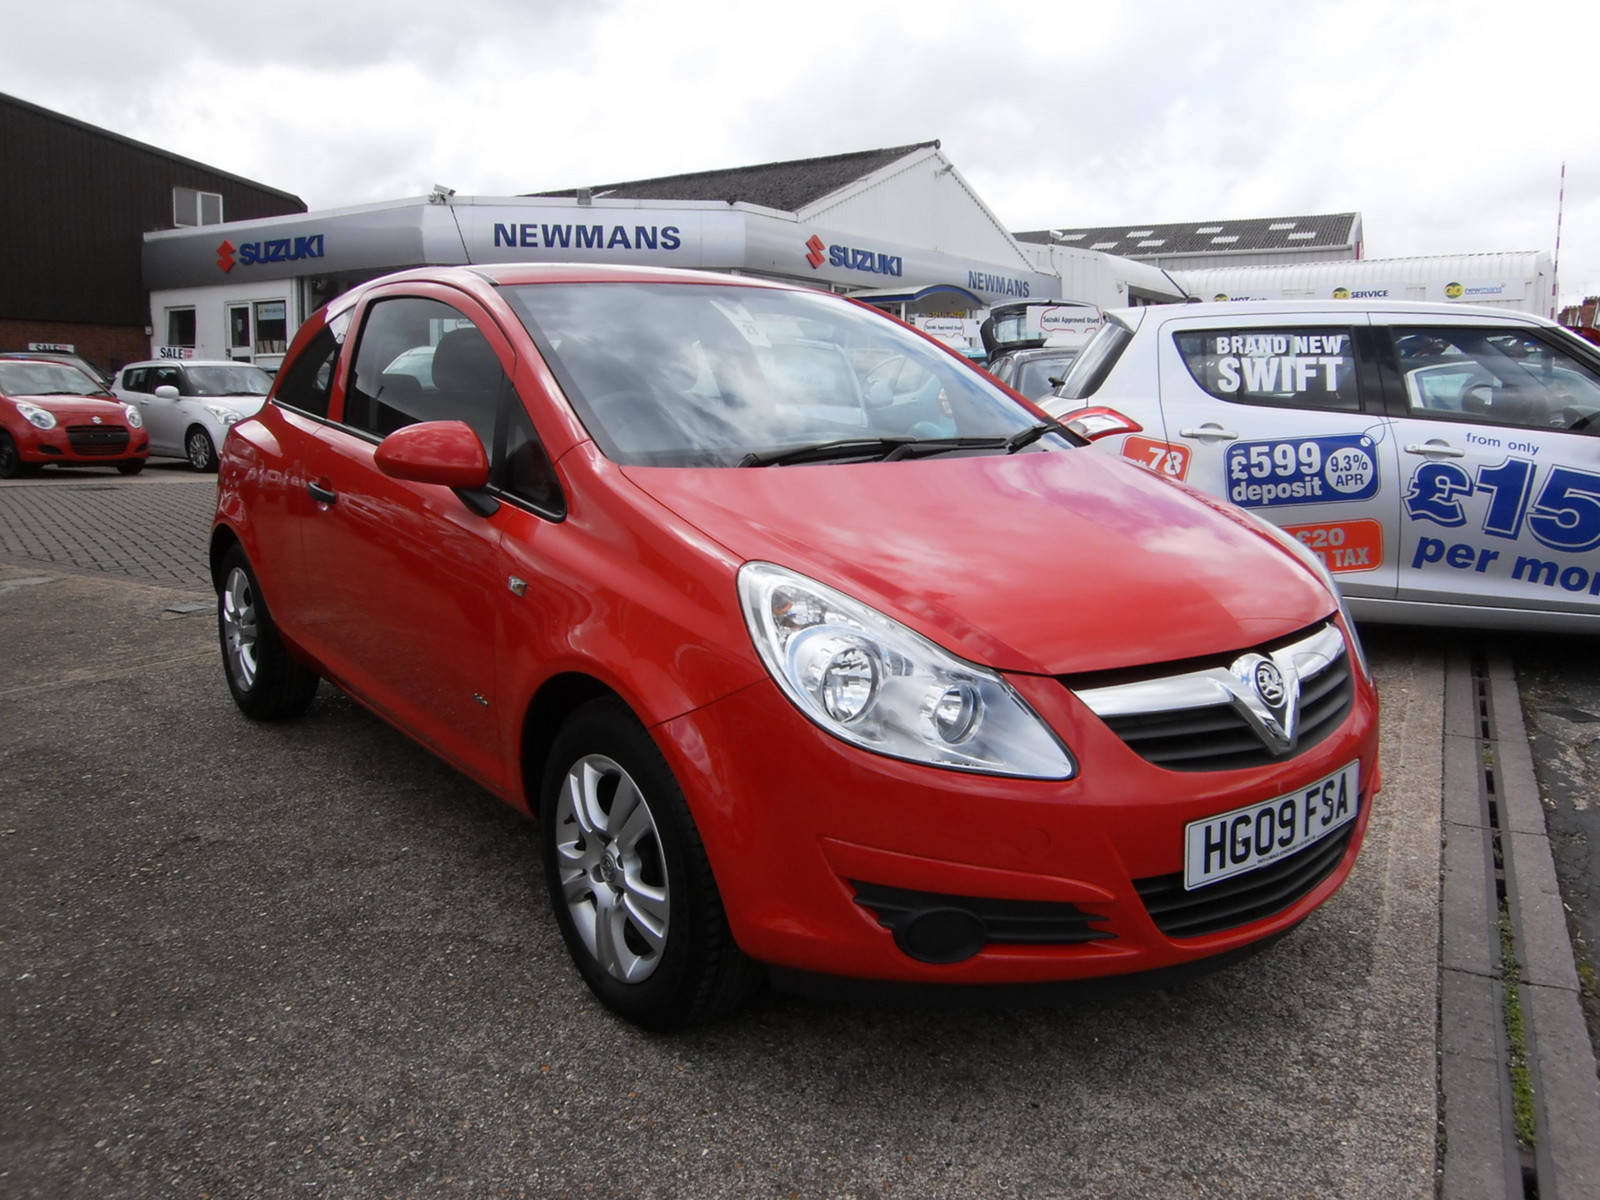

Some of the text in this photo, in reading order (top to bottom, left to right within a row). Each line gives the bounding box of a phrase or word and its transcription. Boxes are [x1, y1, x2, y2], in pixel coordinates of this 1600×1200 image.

[494, 223, 681, 250] NEWMANS
[239, 234, 325, 266] SUZUKI
[829, 244, 903, 277] SUZUKI
[968, 270, 1031, 299] NEWMANS
[1351, 290, 1389, 299] SERVICE
[35, 343, 59, 351] SALE
[160, 347, 184, 360] SALE
[1216, 335, 1343, 355] BRAND NEW
[1217, 356, 1344, 393] SWIFT
[1466, 432, 1540, 456] from only
[1231, 441, 1322, 480] £599
[1330, 454, 1368, 473] 9.3%
[1232, 476, 1323, 504] deposit
[1335, 473, 1365, 487] APR
[1295, 527, 1345, 549] £20
[1332, 547, 1370, 568] TAX
[1411, 536, 1500, 573] per
[1203, 799, 1296, 875] HG09
[1304, 772, 1348, 838] FSA
